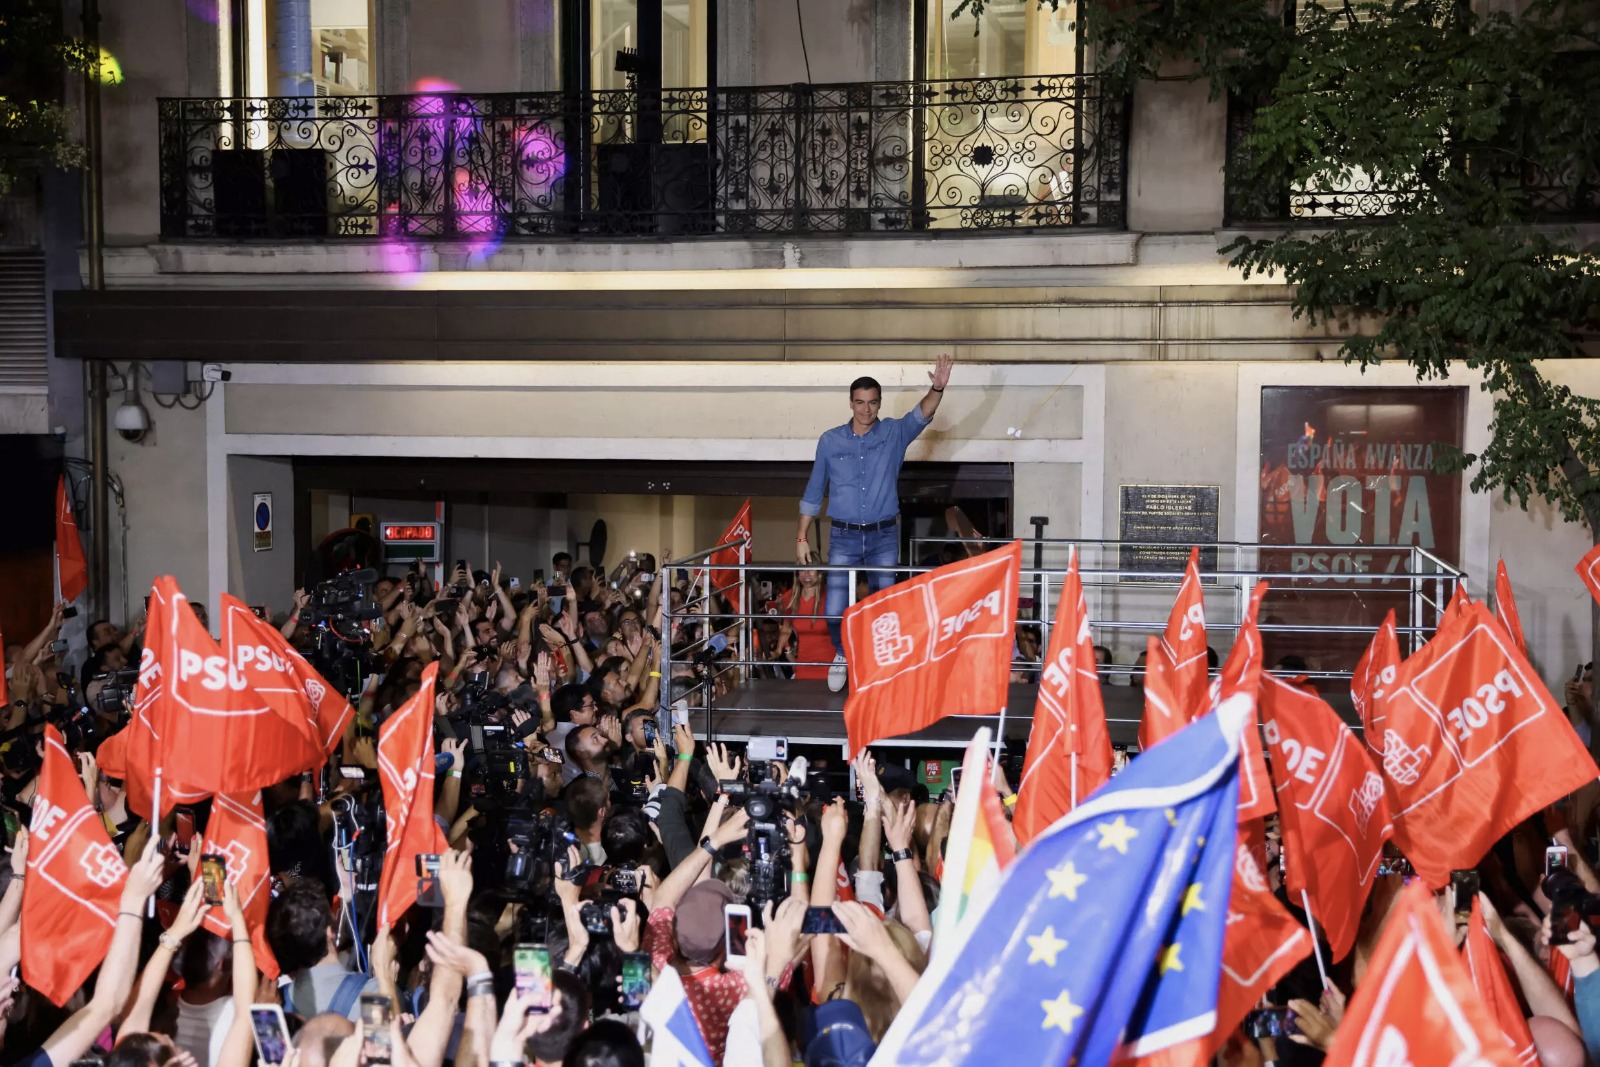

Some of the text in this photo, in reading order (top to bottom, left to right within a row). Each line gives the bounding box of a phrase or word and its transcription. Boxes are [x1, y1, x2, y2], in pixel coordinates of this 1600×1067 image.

[1287, 438, 1434, 470] ESPAÑA AVANZA
[1287, 474, 1436, 549] VOTA
[387, 526, 432, 539] OCUPADO
[1291, 552, 1373, 584] PSOE
